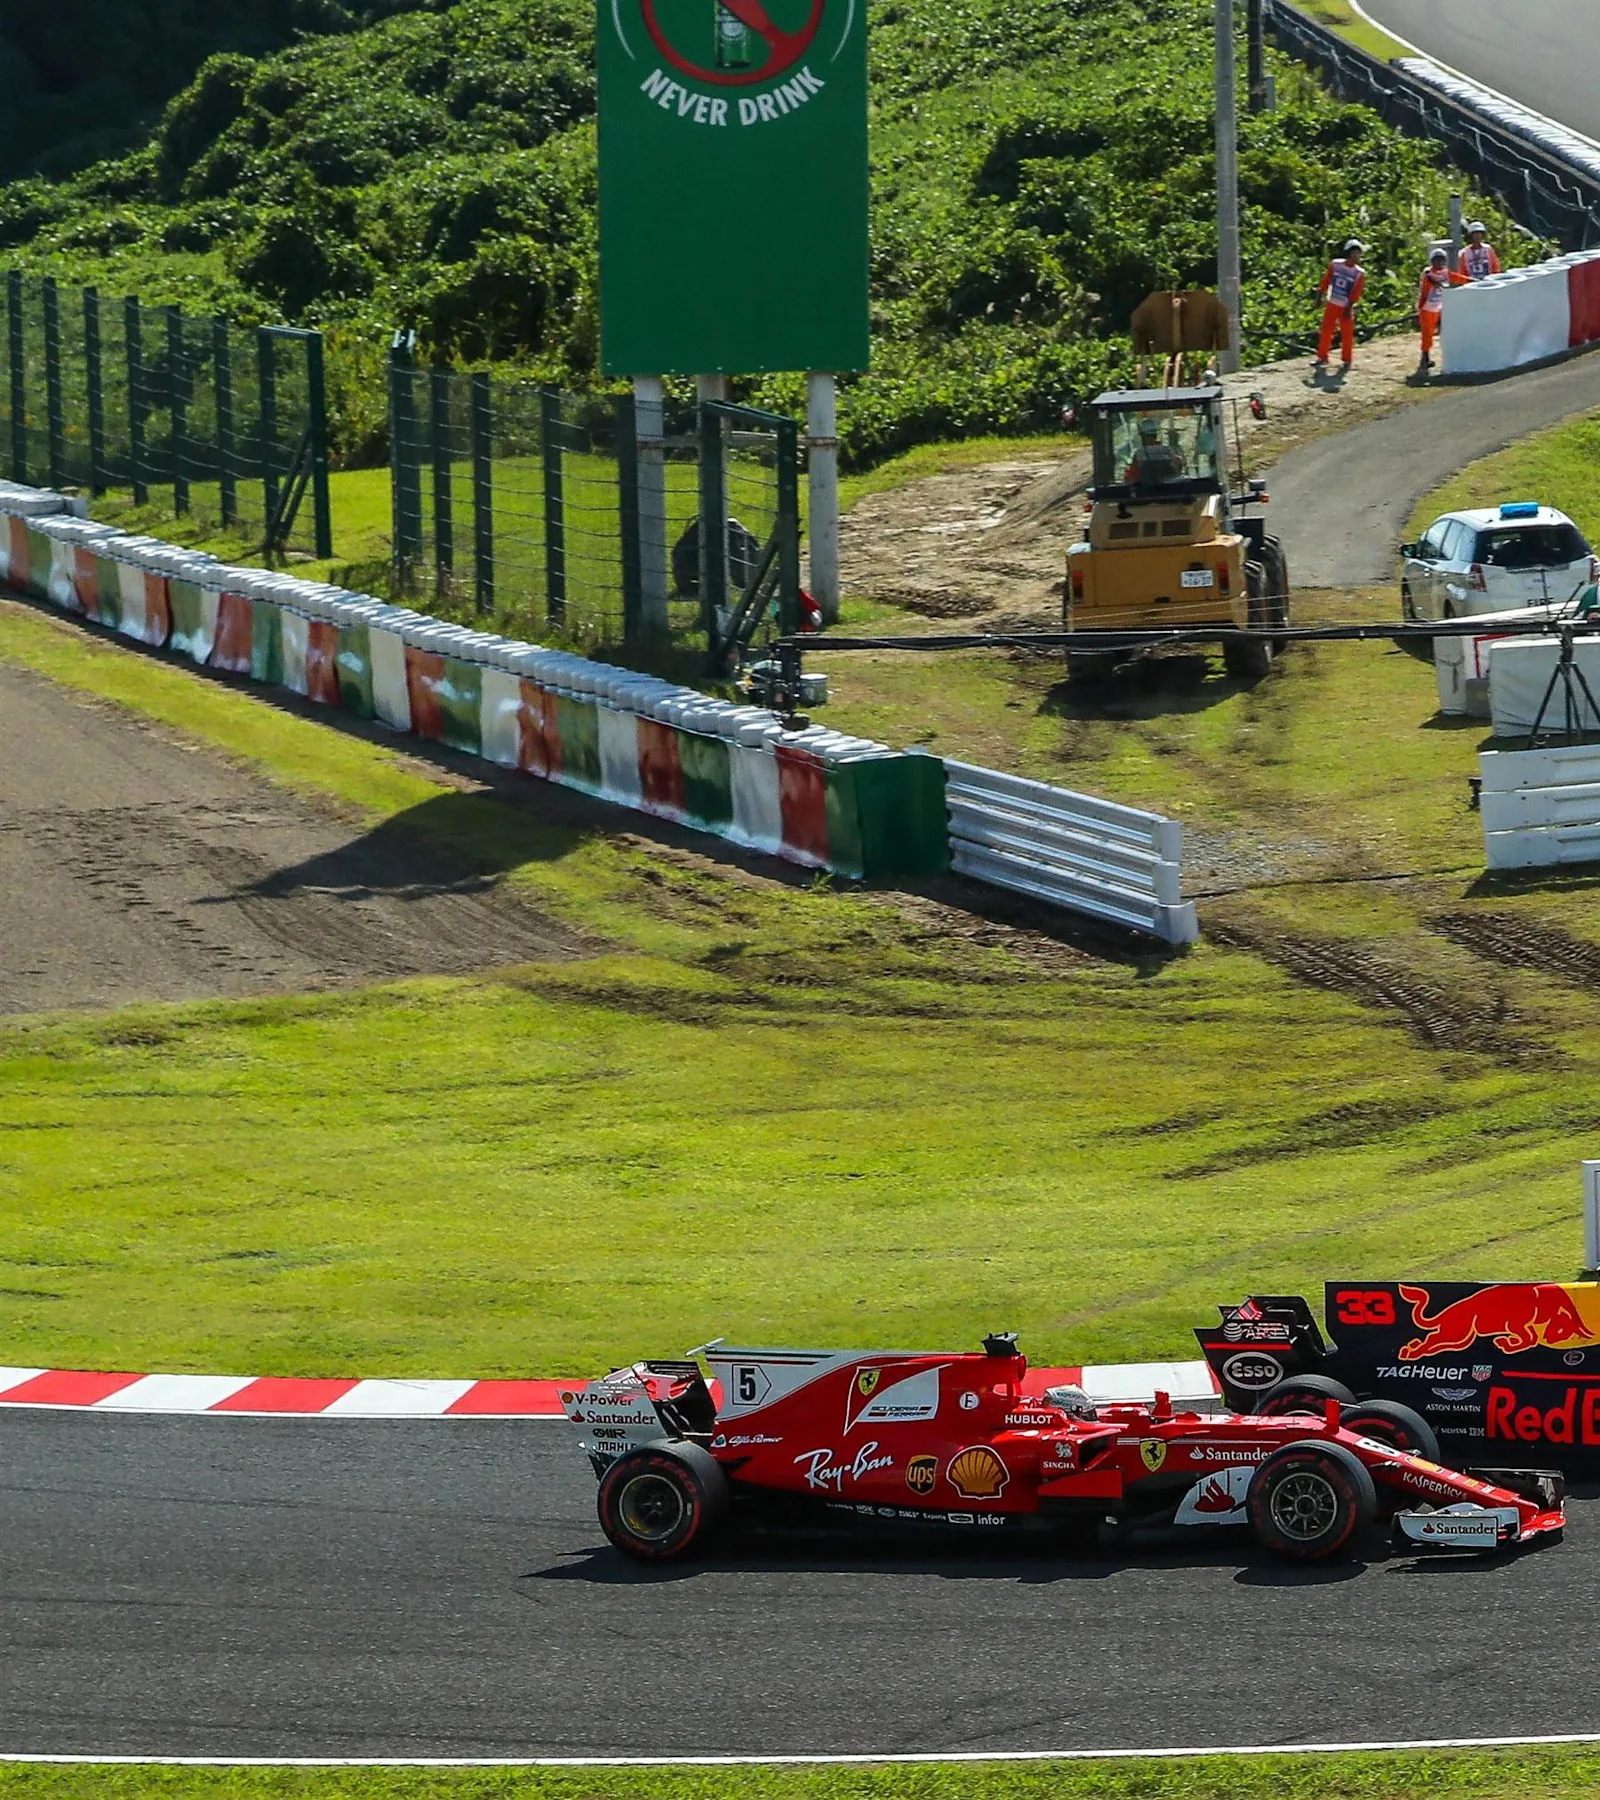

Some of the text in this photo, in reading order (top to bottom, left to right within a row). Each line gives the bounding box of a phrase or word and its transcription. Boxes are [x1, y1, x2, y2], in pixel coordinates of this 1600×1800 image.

[640, 66, 825, 127] NEVER DRINK
[1336, 1290, 1396, 1325] 33
[740, 1368, 756, 1401] 5
[575, 1392, 634, 1406] V-Power
[1425, 1403, 1481, 1413] ASTON MARTIN
[587, 1410, 656, 1425] Santander
[1005, 1414, 1053, 1424] HUBLOT
[1469, 1427, 1485, 1437] IBM
[1043, 1461, 1075, 1469] SINGHA
[908, 1465, 934, 1489] ups
[978, 1514, 1006, 1525] infor
[1436, 1523, 1495, 1535] Santander
